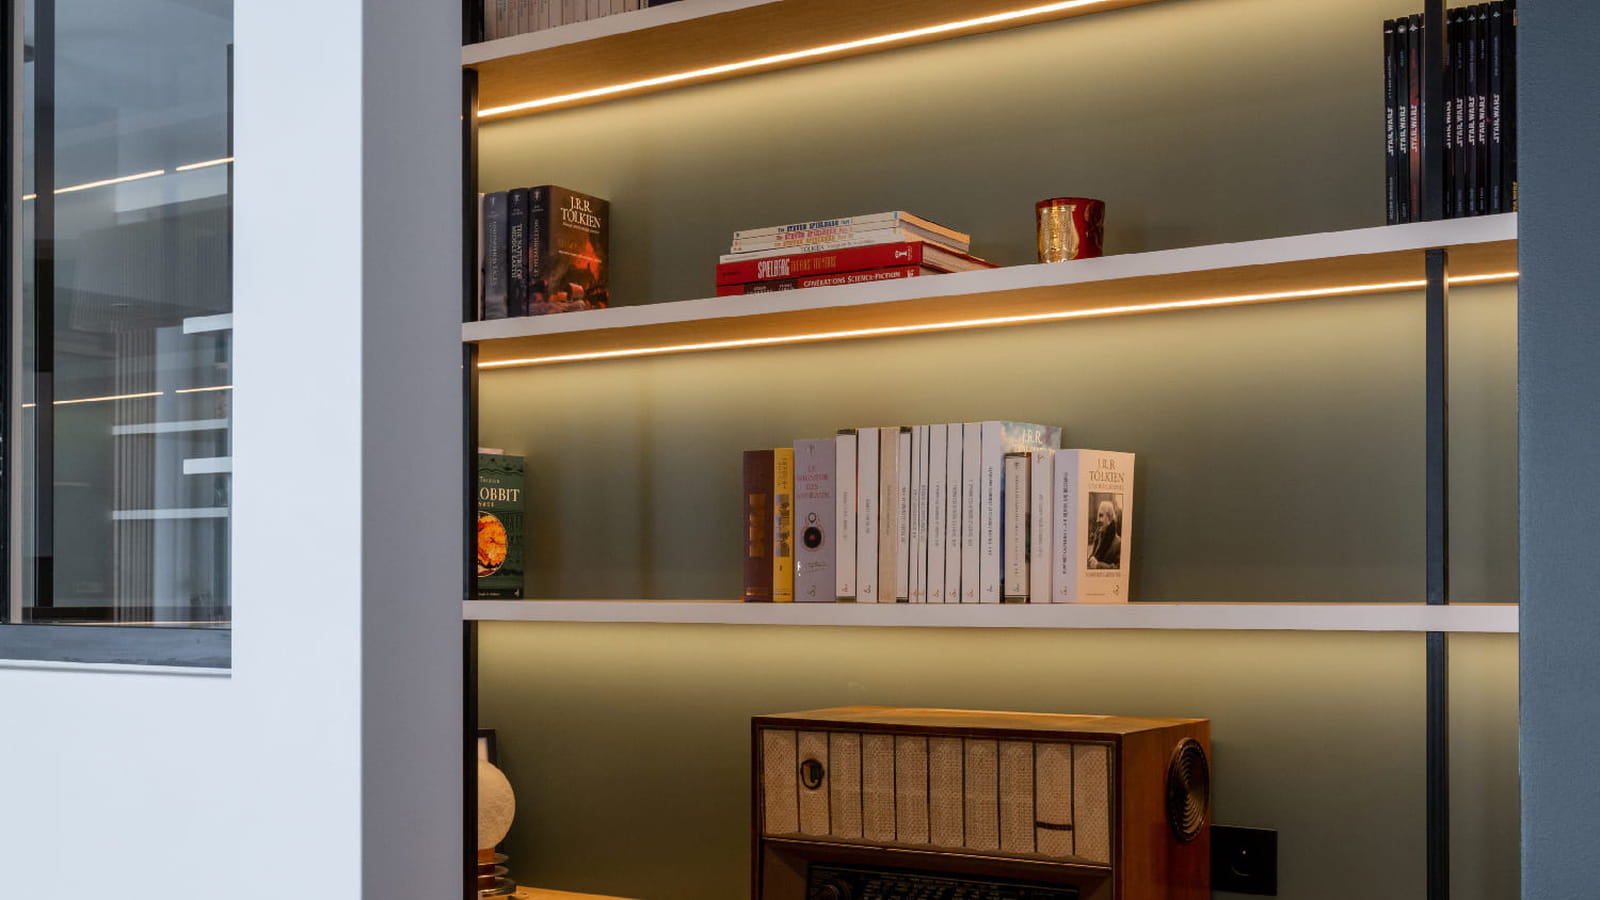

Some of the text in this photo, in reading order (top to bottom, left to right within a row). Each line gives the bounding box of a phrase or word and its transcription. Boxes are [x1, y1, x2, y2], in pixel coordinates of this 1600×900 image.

[560, 208, 601, 228] TOLKIEN
[809, 220, 839, 229] SPIELBERG
[758, 258, 790, 279] SPIELBERG
[847, 271, 901, 283] SCIENCE-FICTION
[1088, 470, 1125, 483] TOLKIEN
[480, 487, 520, 502] OBBIT
